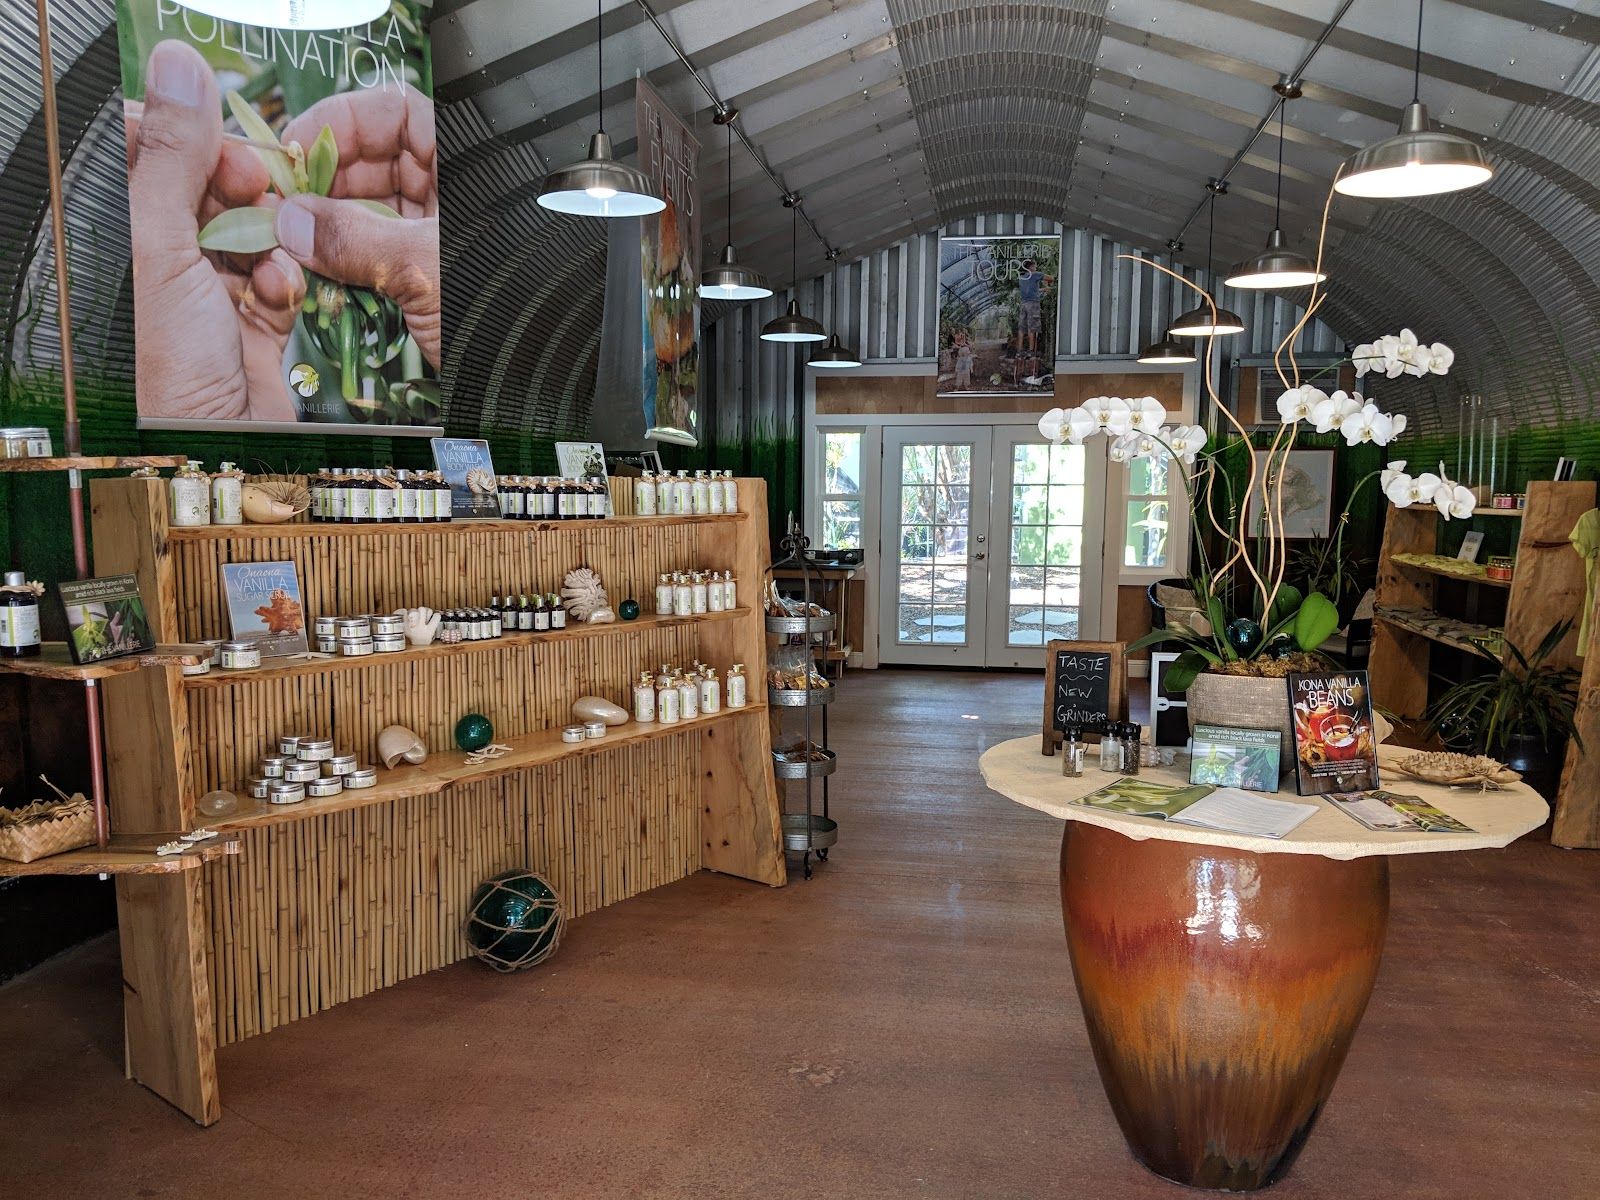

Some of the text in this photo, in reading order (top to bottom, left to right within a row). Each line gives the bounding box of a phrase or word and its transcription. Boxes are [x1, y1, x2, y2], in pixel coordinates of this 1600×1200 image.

[156, 0, 406, 97] POLLINATION
[967, 259, 1033, 281] TOURS
[441, 451, 485, 465] VANILLA
[234, 577, 289, 593] VANILLA
[236, 591, 264, 602] SUGAR
[1059, 655, 1109, 672] TASTE
[1058, 684, 1092, 699] NEW
[1298, 676, 1361, 692] KONA VANILLA
[1308, 688, 1355, 709] BEANS
